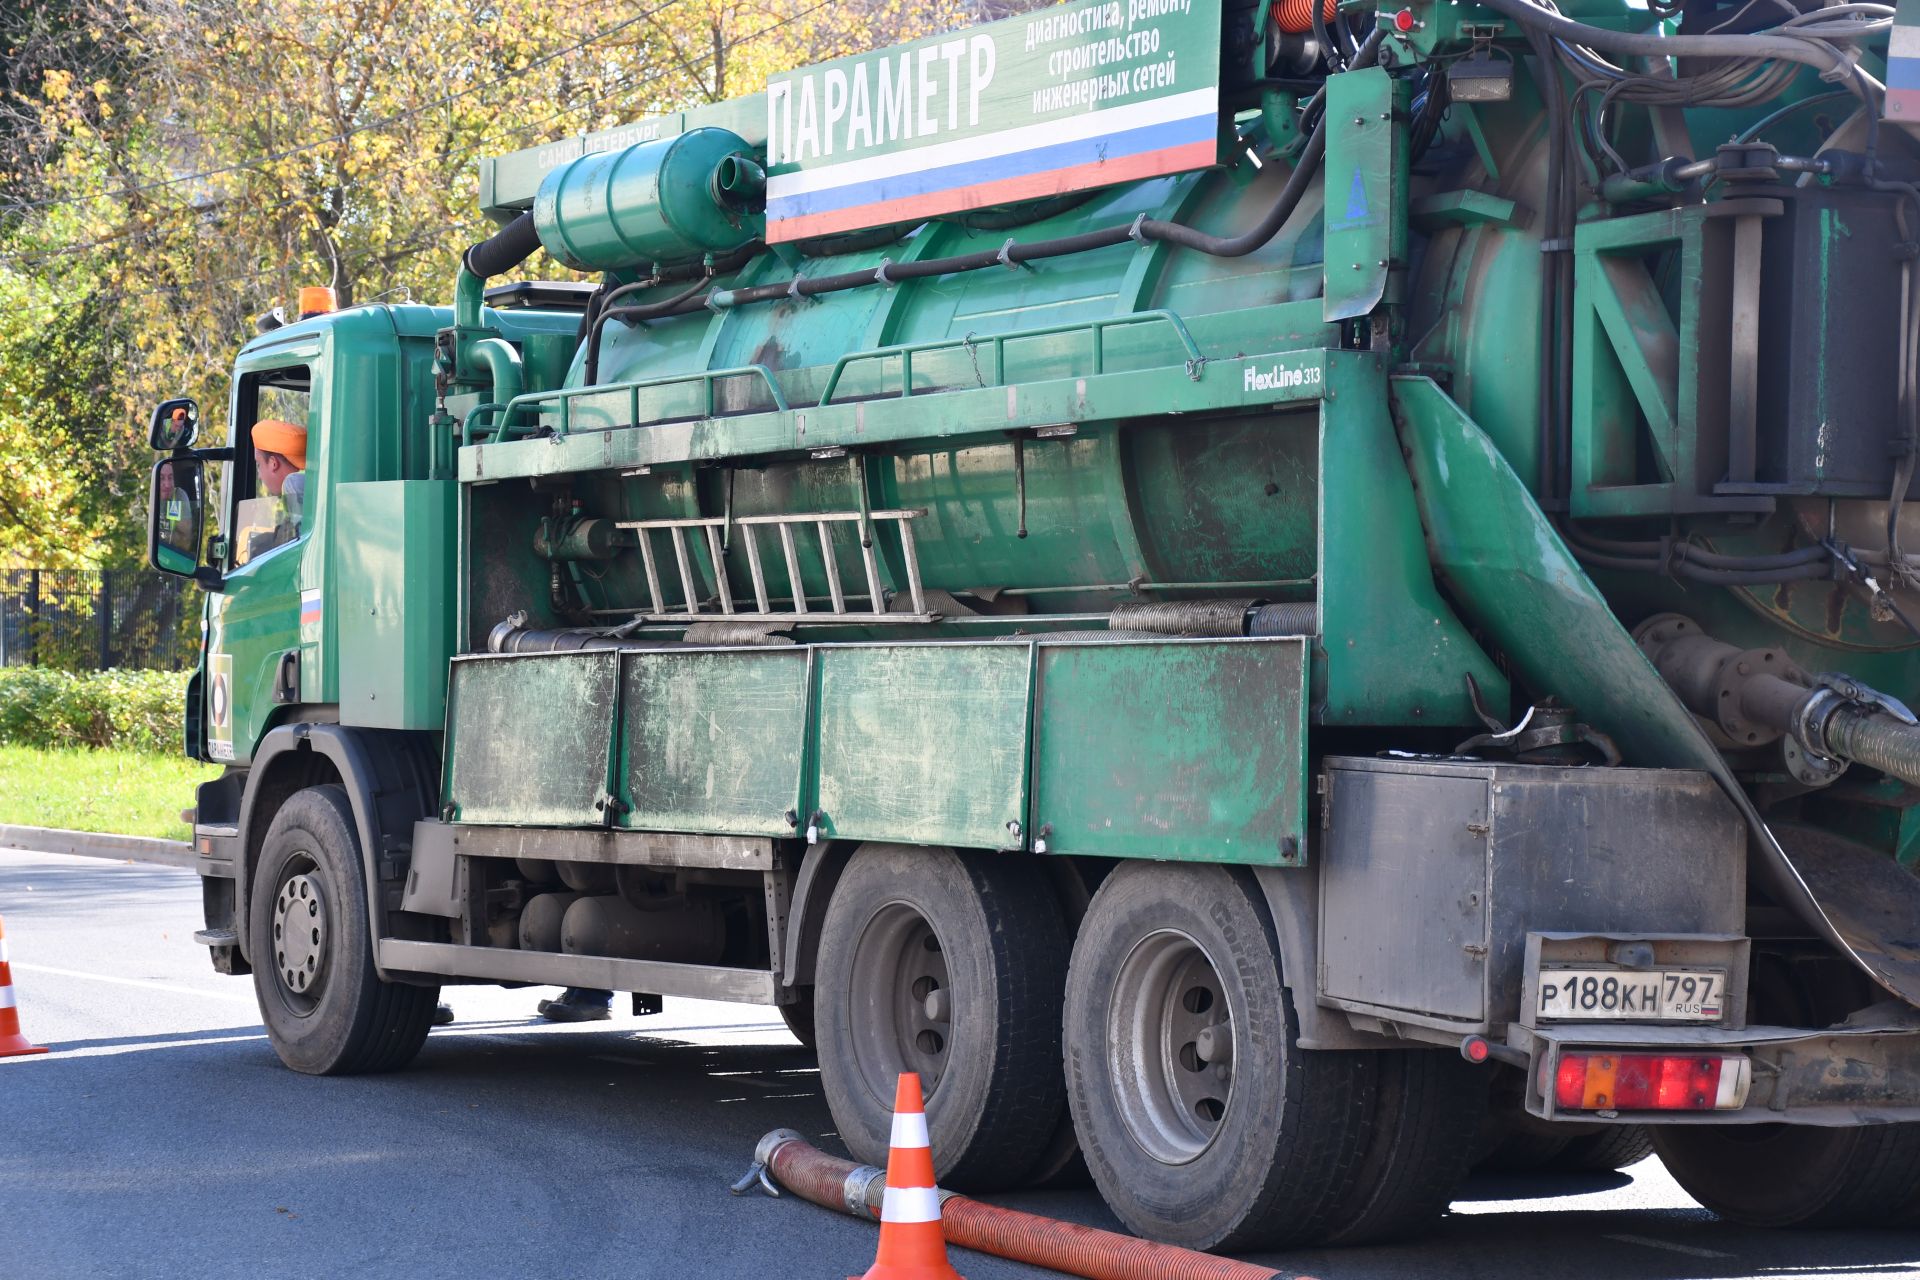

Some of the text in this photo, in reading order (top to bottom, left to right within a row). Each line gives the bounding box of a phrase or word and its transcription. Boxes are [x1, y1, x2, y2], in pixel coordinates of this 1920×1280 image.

[1025, 0, 1125, 52] диагностика,
[1048, 27, 1160, 81] строительство
[767, 33, 997, 168] ПАРАМЕТР
[1032, 50, 1176, 114] инженерных сетей
[1244, 363, 1321, 392] FlexLine 313
[1665, 975, 1714, 1003] 797
[1675, 1003, 1700, 1013] RUS
